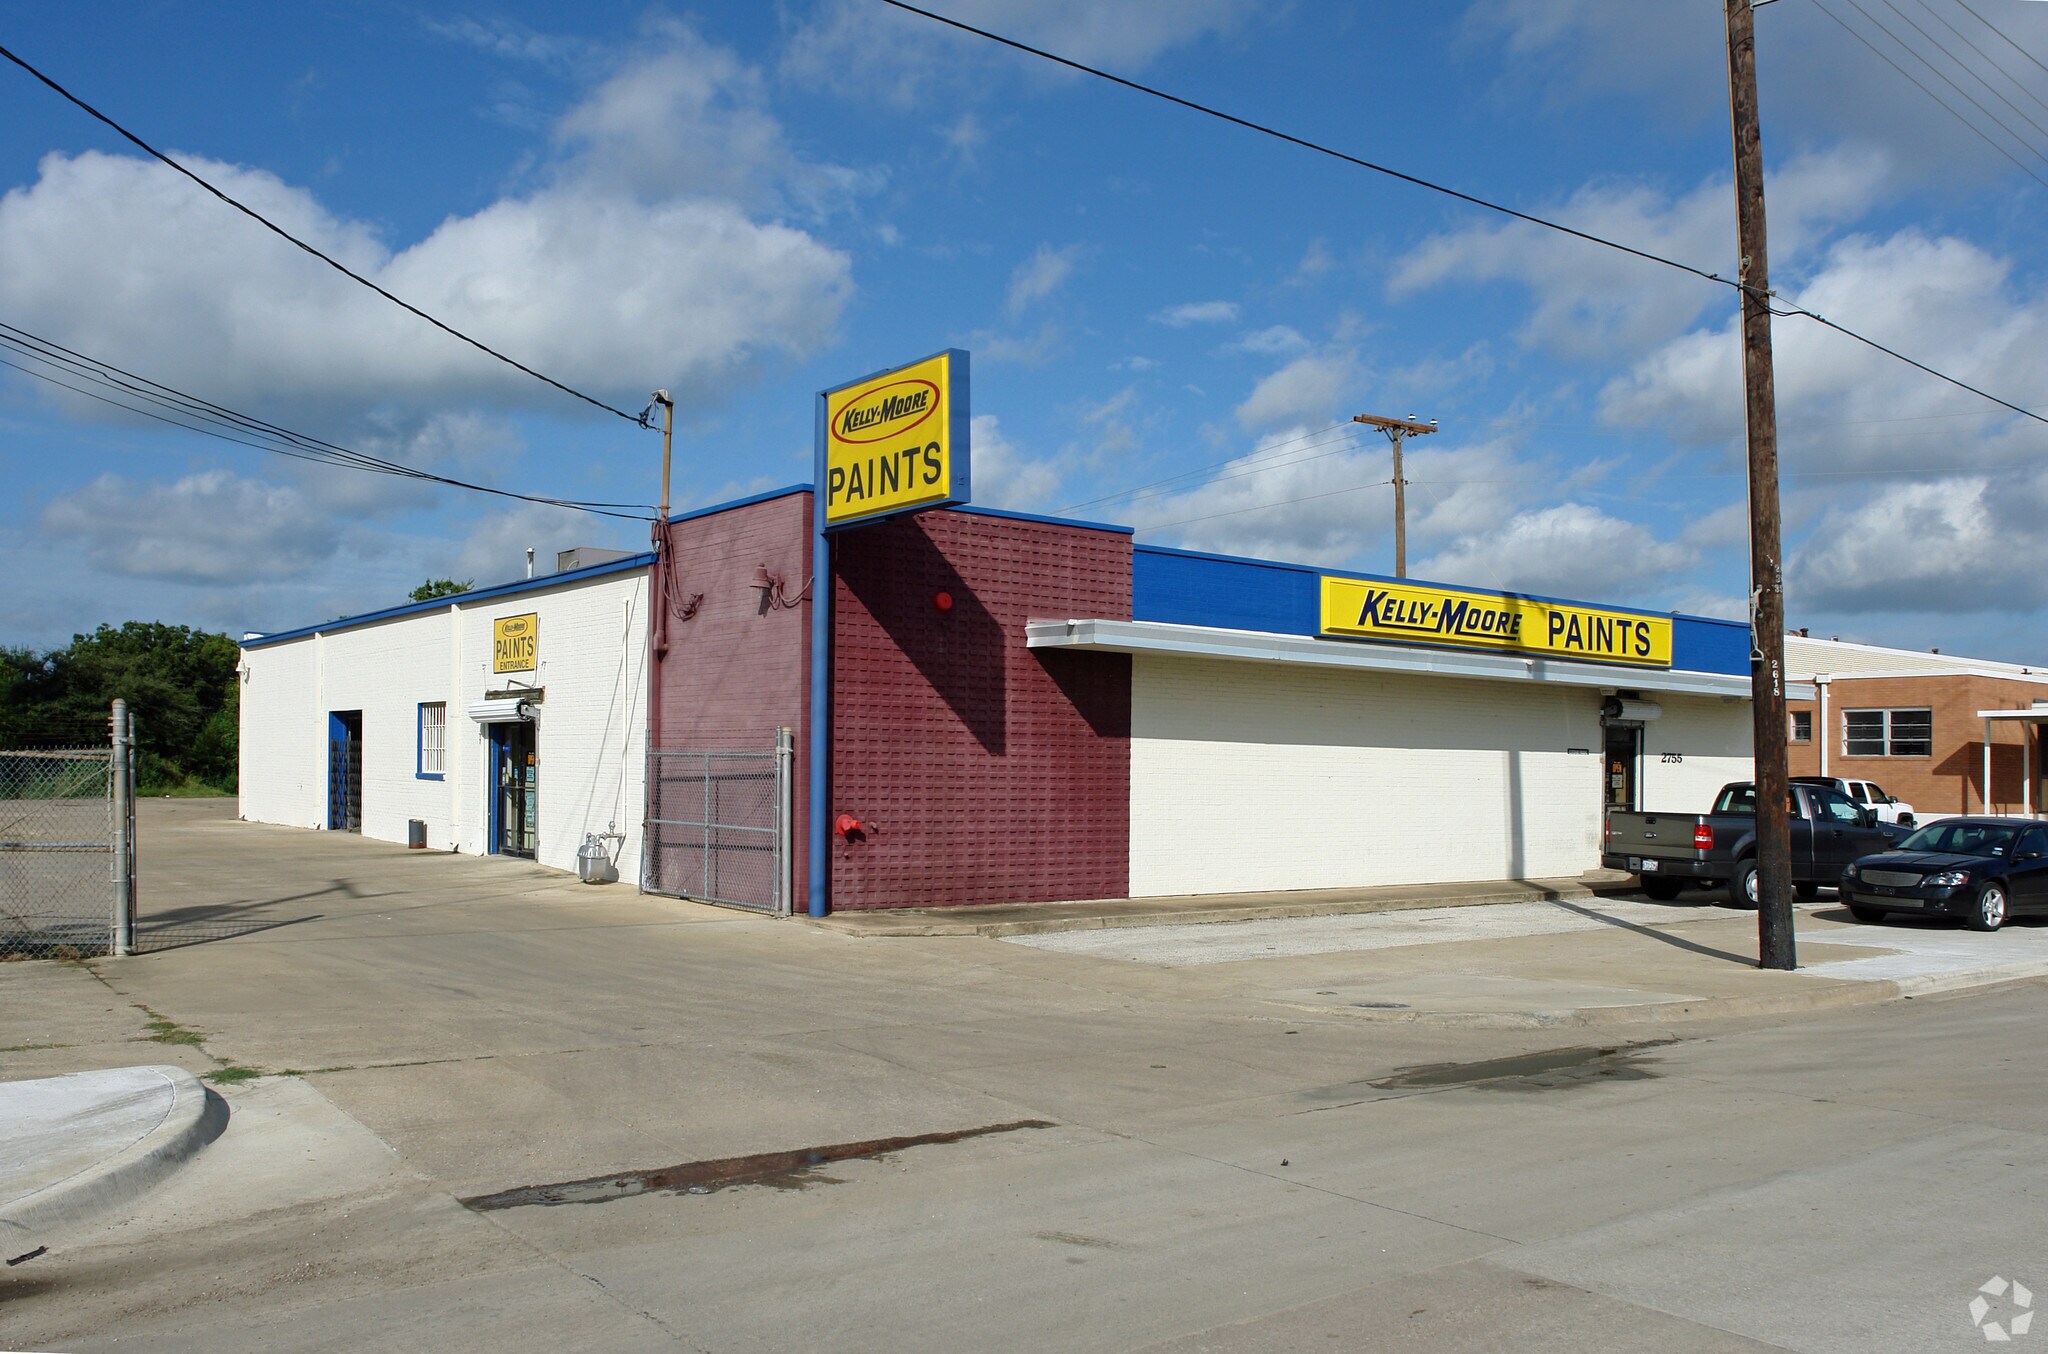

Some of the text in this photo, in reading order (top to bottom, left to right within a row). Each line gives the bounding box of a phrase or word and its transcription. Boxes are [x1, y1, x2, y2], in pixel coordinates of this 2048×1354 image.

[842, 389, 929, 434] KELLY-MOORE
[829, 441, 941, 506] PAINTS
[1358, 590, 1651, 656] KELLY-MOORE PAINTS
[496, 636, 534, 660] PAINTS
[500, 659, 529, 670] ENTRANCE
[1771, 660, 1780, 696] 2618
[1660, 752, 1683, 763] 2755
